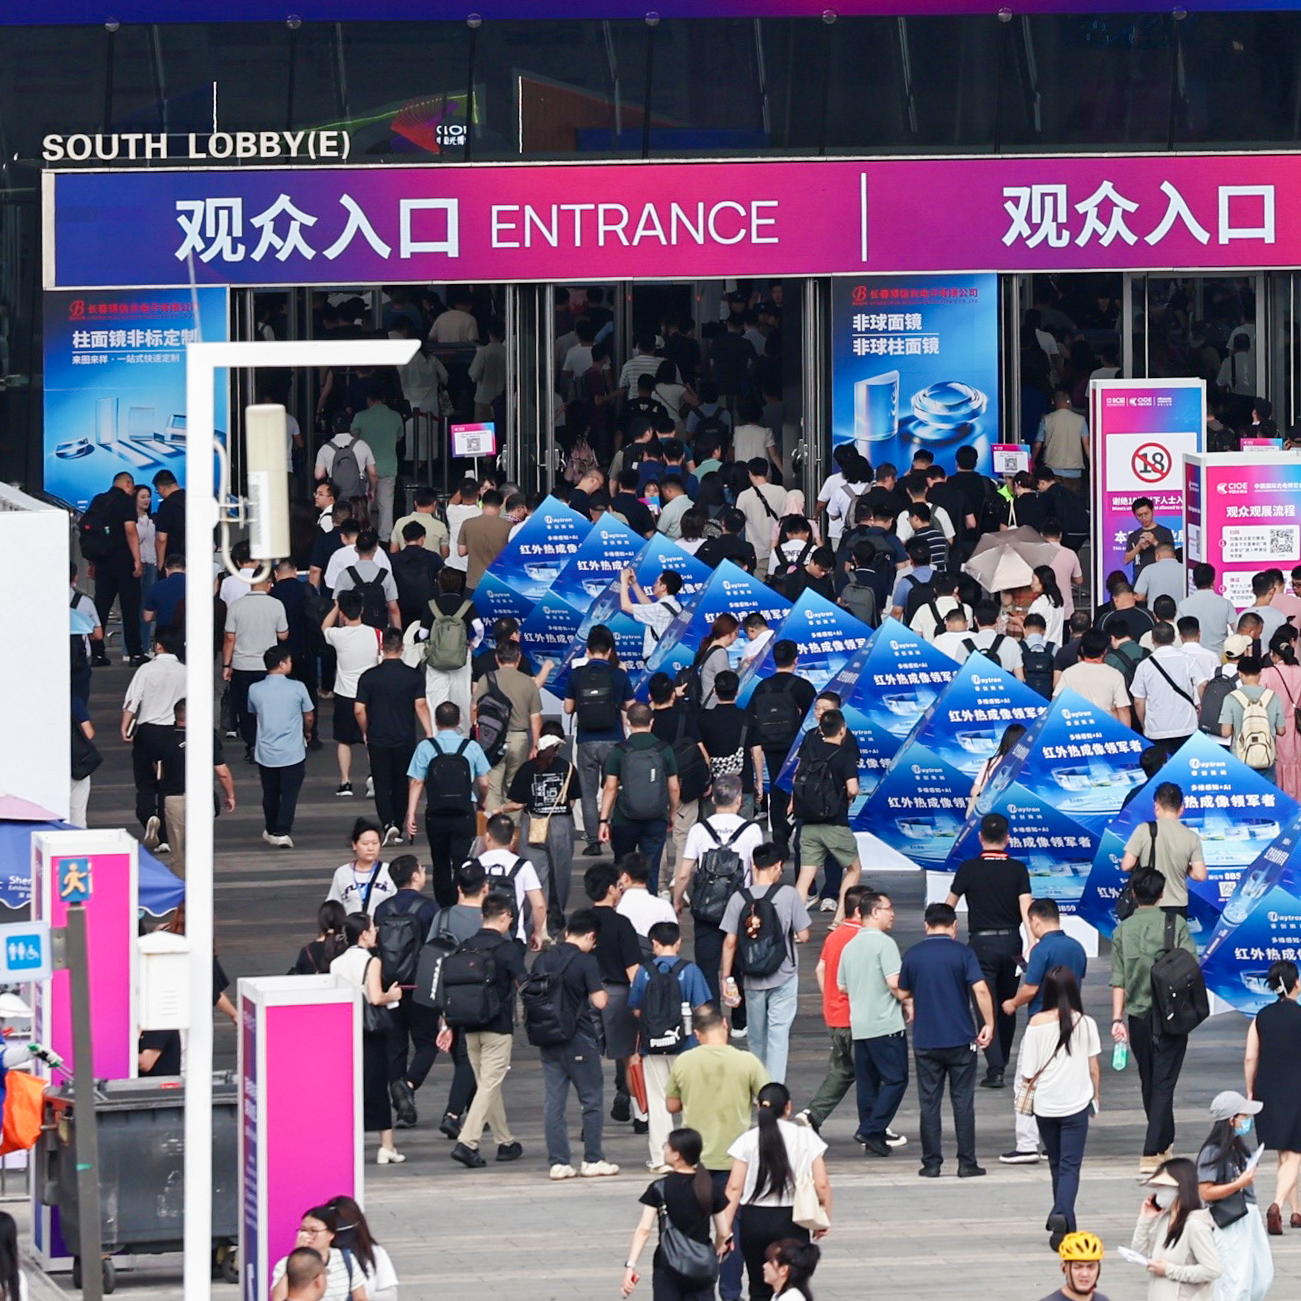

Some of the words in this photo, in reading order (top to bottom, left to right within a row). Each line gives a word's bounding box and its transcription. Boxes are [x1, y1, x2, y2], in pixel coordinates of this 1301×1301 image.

[42, 132, 169, 162] SOUTH
[188, 130, 350, 162] LOBBY(E)
[1001, 179, 1275, 249] 观众入口
[174, 193, 460, 264] 观众入口
[489, 199, 780, 250] ENTRANCE
[852, 313, 922, 331] 非球面镜
[72, 328, 199, 348] 柱面镜非标定制
[852, 337, 940, 356] 非球柱面镜
[1139, 452, 1165, 474] 18
[1228, 482, 1248, 490] CIOE
[1226, 505, 1296, 518] 观众观展流程
[1042, 740, 1142, 759] 红外热成像领军者
[1225, 872, 1241, 880] 8B5
